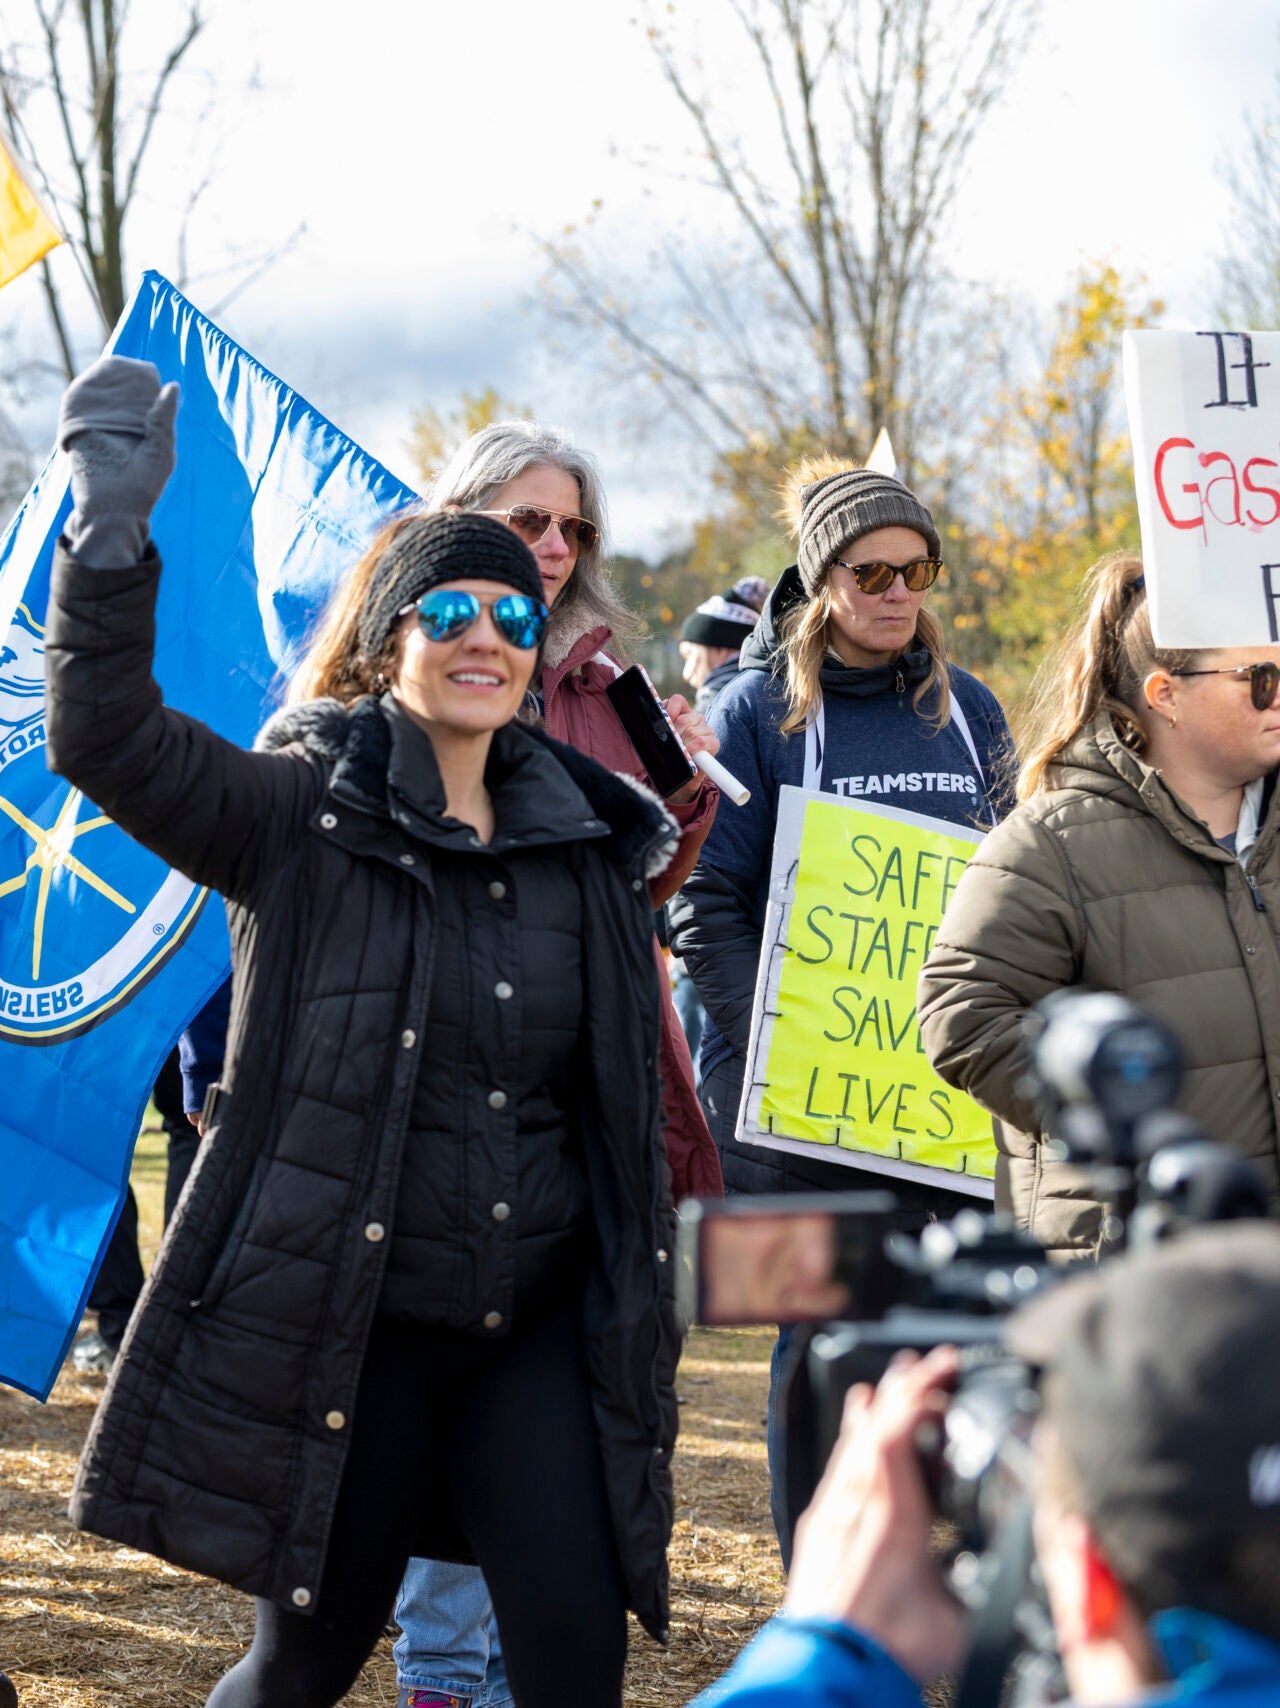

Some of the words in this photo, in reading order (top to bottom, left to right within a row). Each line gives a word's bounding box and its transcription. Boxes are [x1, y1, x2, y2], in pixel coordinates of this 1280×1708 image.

[1154, 437, 1280, 546] Gas
[832, 772, 977, 796] TEAMSTERS
[796, 905, 939, 981] STAF
[823, 985, 926, 1054] SAV
[804, 1066, 954, 1140] LIVES
